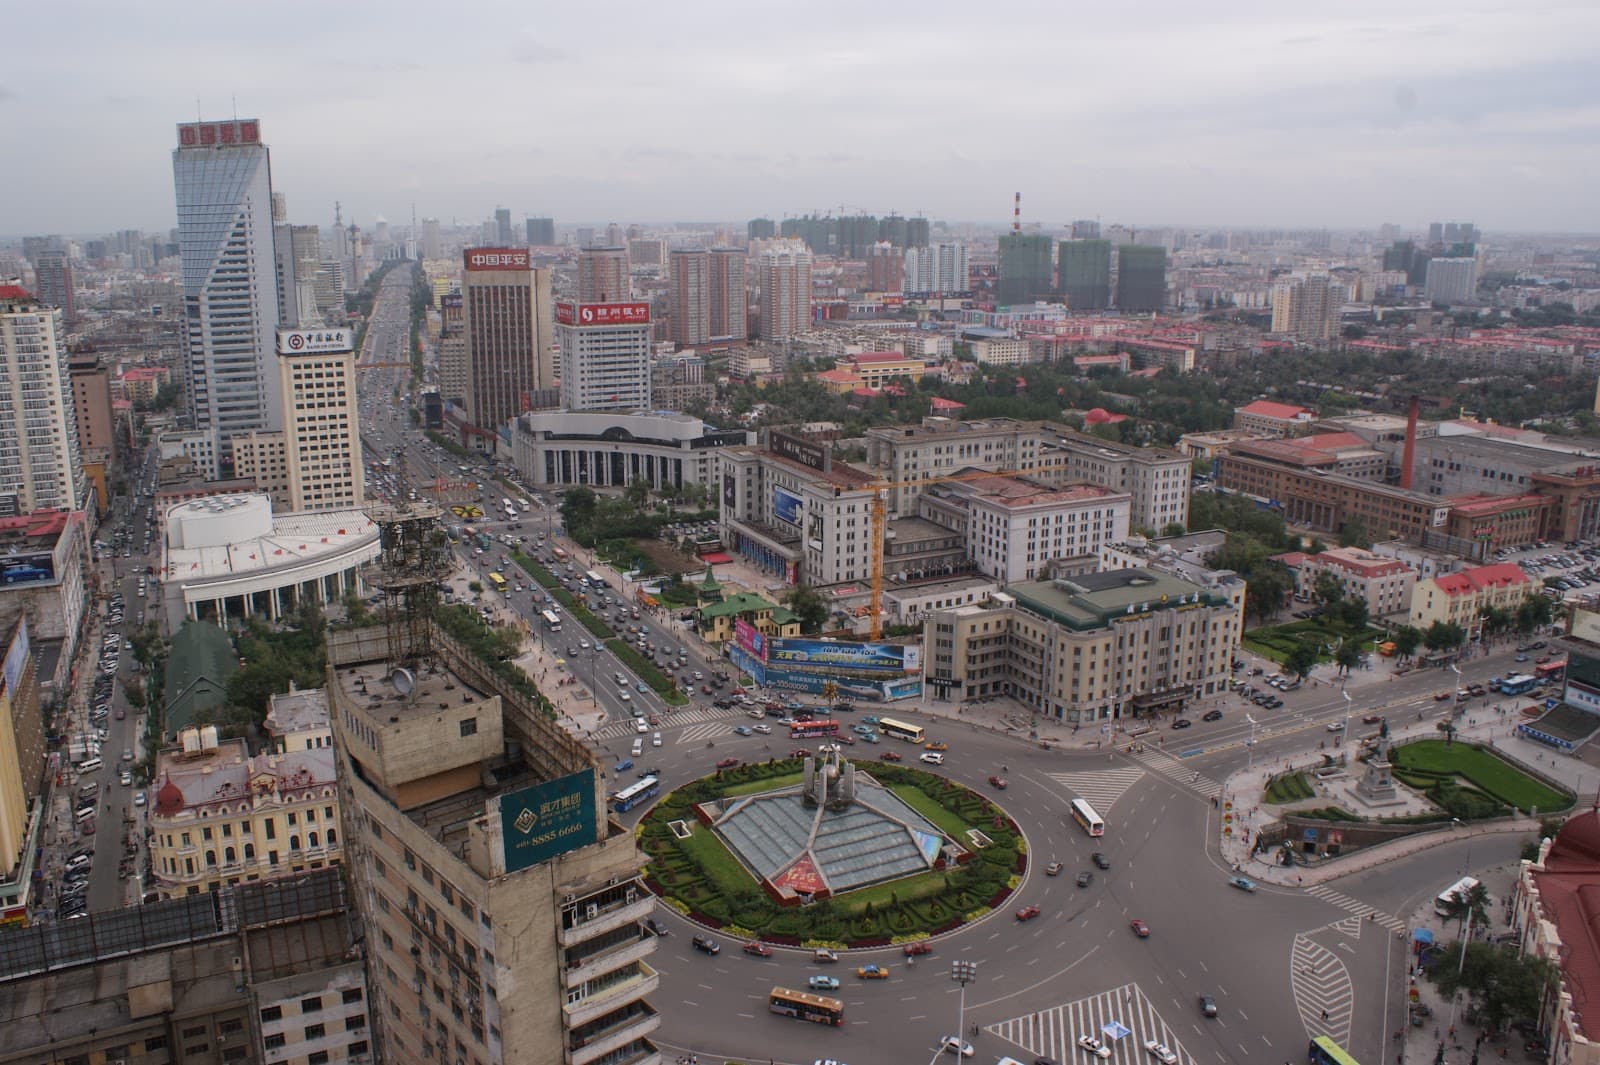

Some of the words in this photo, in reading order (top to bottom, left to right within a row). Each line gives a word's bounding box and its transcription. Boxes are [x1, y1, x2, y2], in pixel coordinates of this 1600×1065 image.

[471, 253, 526, 267] 中国平安
[558, 823, 582, 837] 6666
